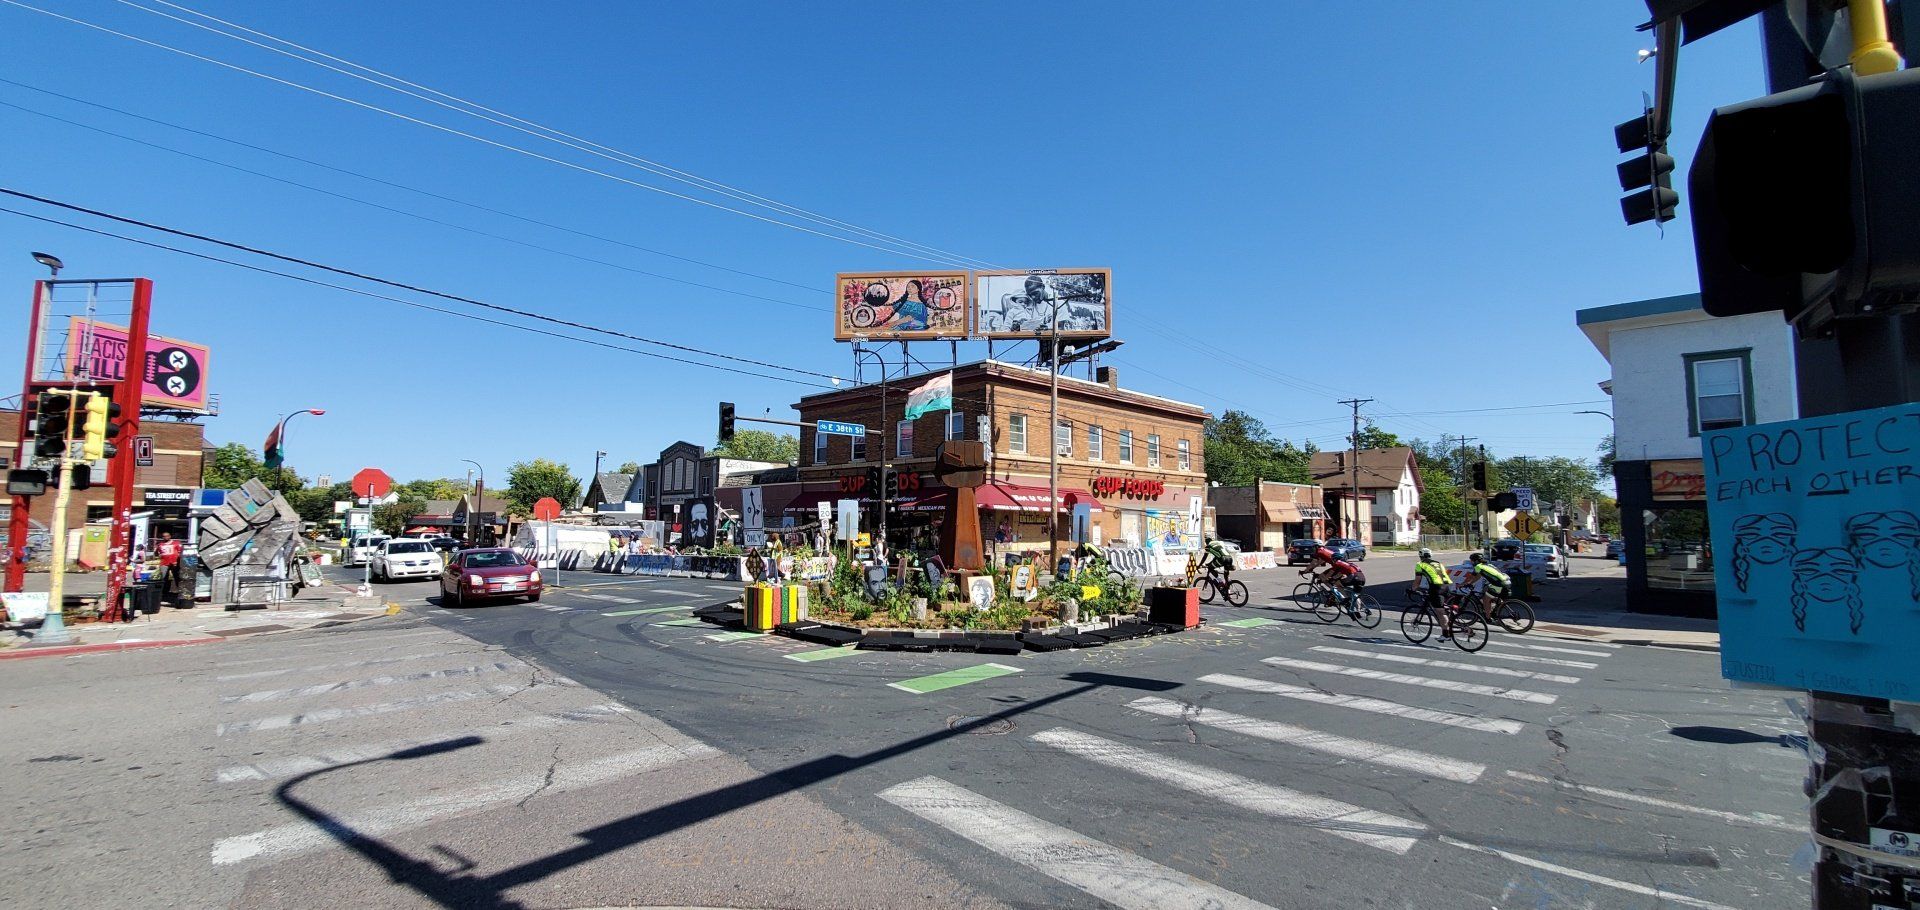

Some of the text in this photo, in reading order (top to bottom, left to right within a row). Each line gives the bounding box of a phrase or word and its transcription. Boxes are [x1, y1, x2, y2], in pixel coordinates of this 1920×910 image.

[81, 332, 126, 361] RACIS
[828, 423, 863, 434] E 38th St
[840, 474, 865, 493] CUP
[1096, 476, 1164, 496] CUP FOODS
[1717, 464, 1920, 501] EACH OTHER
[746, 533, 762, 543] ONLY
